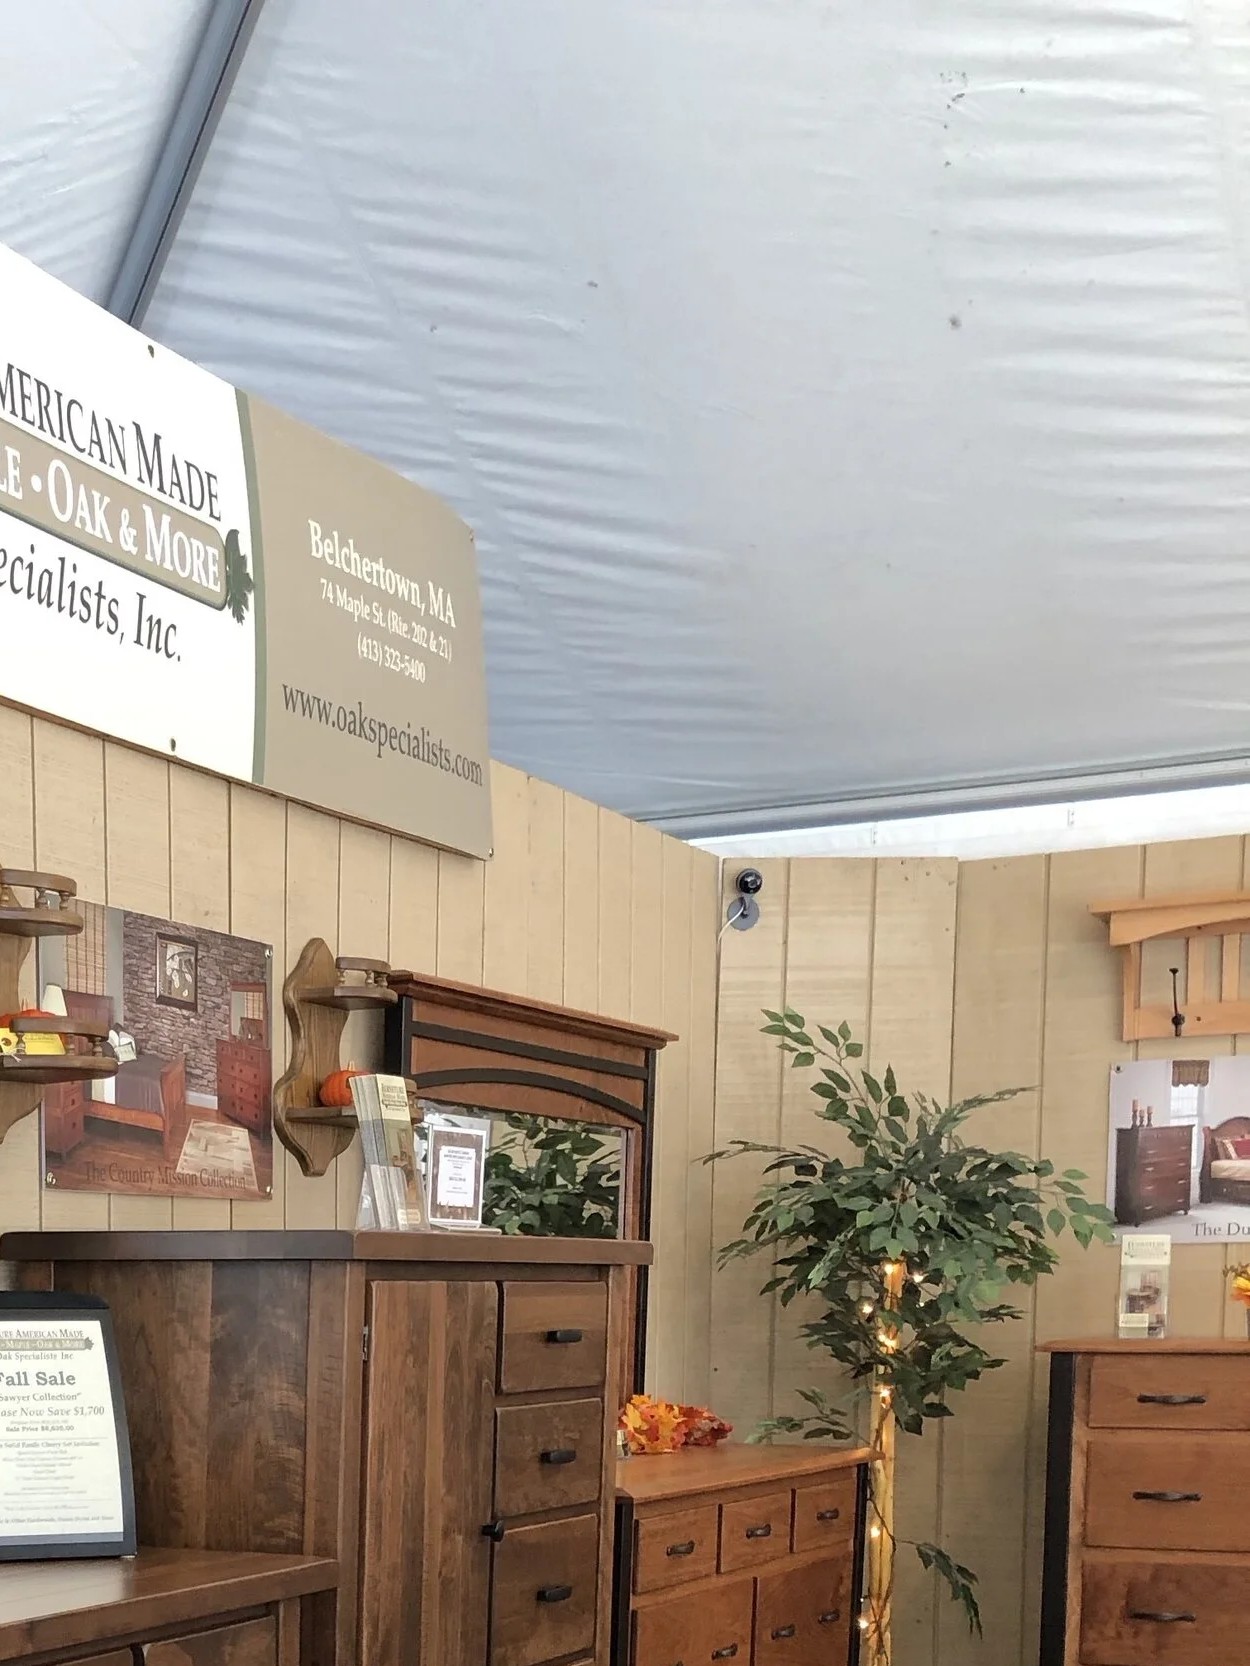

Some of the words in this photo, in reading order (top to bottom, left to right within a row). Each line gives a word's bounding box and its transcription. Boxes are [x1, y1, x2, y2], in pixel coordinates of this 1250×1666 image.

[132, 421, 221, 522] MADE
[48, 459, 113, 545] OAK
[119, 507, 138, 556] &
[143, 504, 221, 593] MORE
[308, 519, 426, 617] Belchertown,
[428, 581, 456, 628] MA
[133, 592, 181, 662] Inc.
[320, 578, 334, 603] 74
[336, 584, 370, 623] Maple
[372, 602, 386, 629] St.
[388, 609, 411, 639] (Rte.
[412, 621, 428, 645] 202
[429, 630, 438, 652] &
[439, 636, 452, 663] 21)
[357, 632, 382, 666] (413)
[384, 644, 426, 684] 323-5400
[282, 683, 483, 786] www.oakspecialists.com
[84, 1160, 106, 1182] The
[108, 1163, 155, 1186] Country
[158, 1166, 198, 1186] Mission
[199, 1168, 246, 1190] Collection
[1191, 1222, 1222, 1237] The
[16, 1329, 58, 1338] AMERICAN
[59, 1328, 84, 1338] MADE
[35, 1371, 76, 1386] Sale
[20, 1407, 44, 1417] Now
[47, 1407, 70, 1416] Save
[73, 1406, 105, 1417] $1,700
